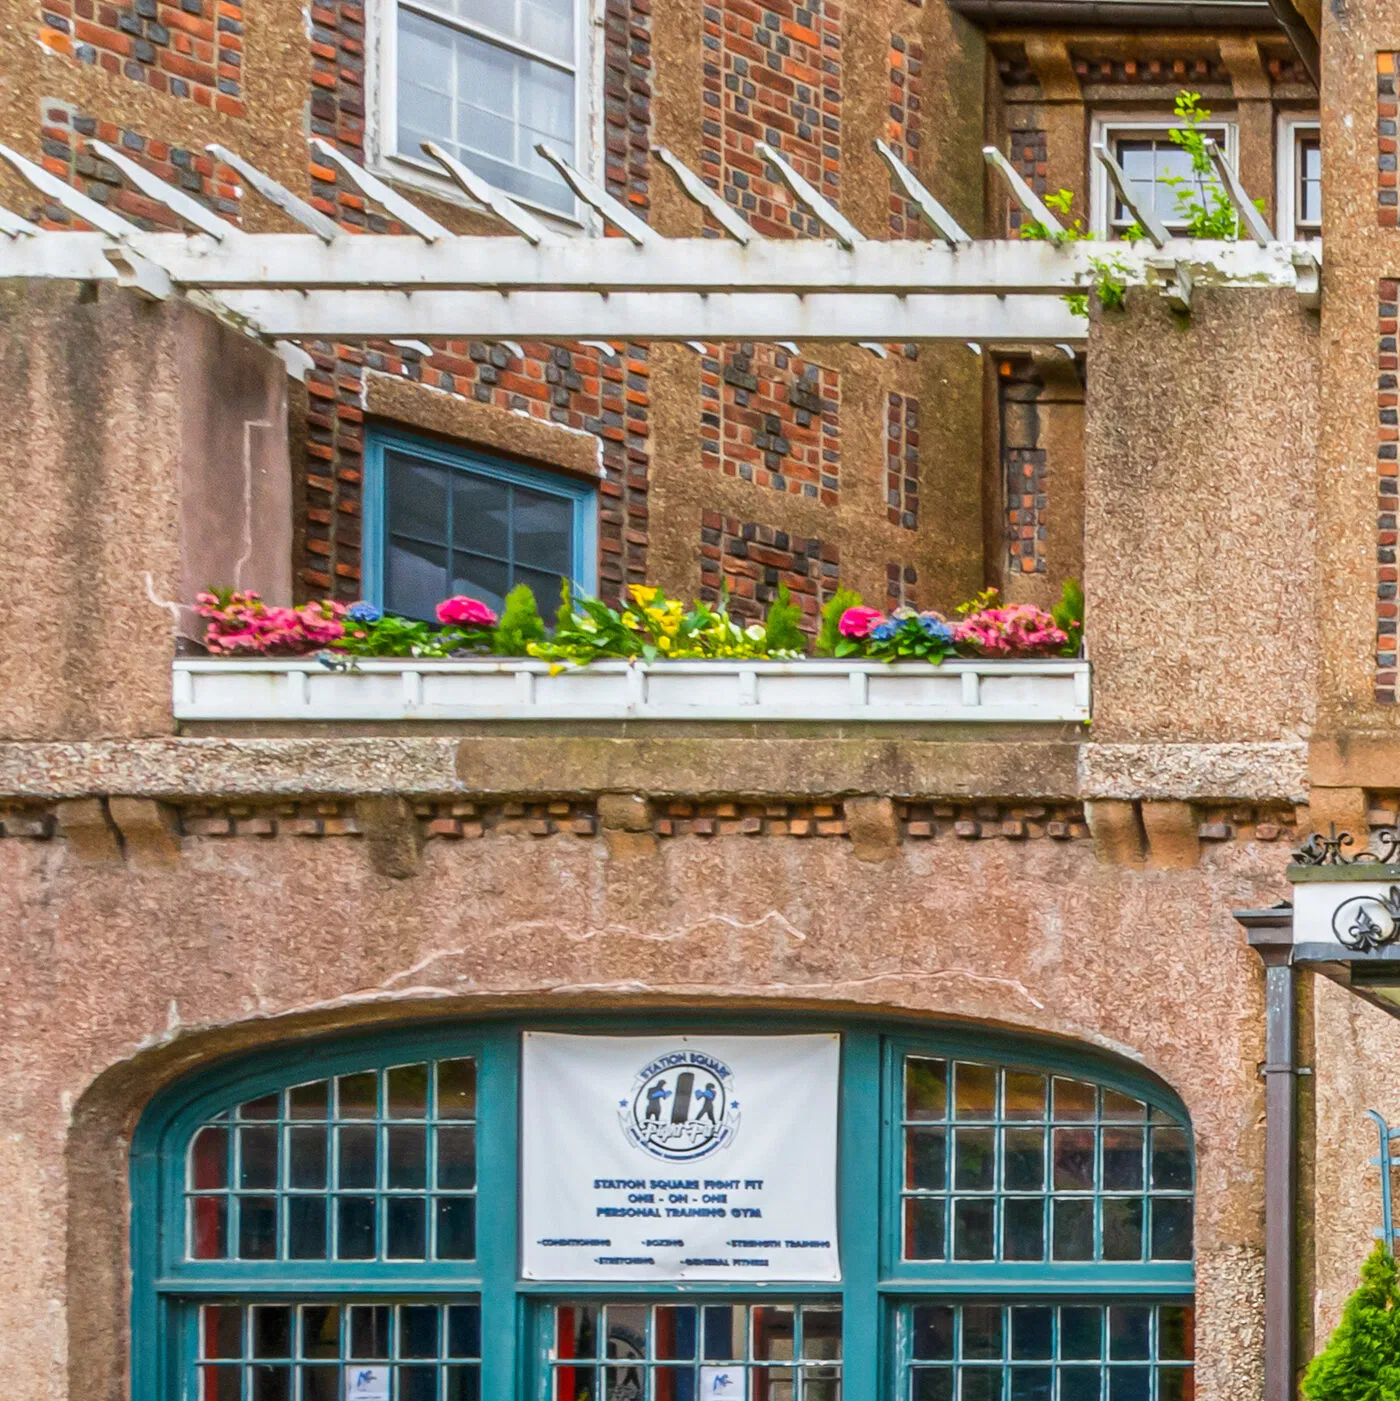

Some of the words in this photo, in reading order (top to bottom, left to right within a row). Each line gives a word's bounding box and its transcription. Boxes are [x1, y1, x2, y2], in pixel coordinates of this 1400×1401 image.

[639, 1053, 687, 1079] STATION
[689, 1053, 731, 1080] SQUARE
[593, 1179, 647, 1190] STATION
[649, 1179, 700, 1191] SQUARE
[703, 1179, 741, 1190] FIGHT
[744, 1179, 764, 1190] FIT
[627, 1193, 655, 1203] ONE
[668, 1194, 689, 1203] ON
[701, 1194, 728, 1204] ONE
[596, 1207, 662, 1218] PERSONAL
[664, 1207, 727, 1218] TRAINING
[730, 1208, 763, 1218] GYM
[784, 1240, 831, 1249] TRAINING
